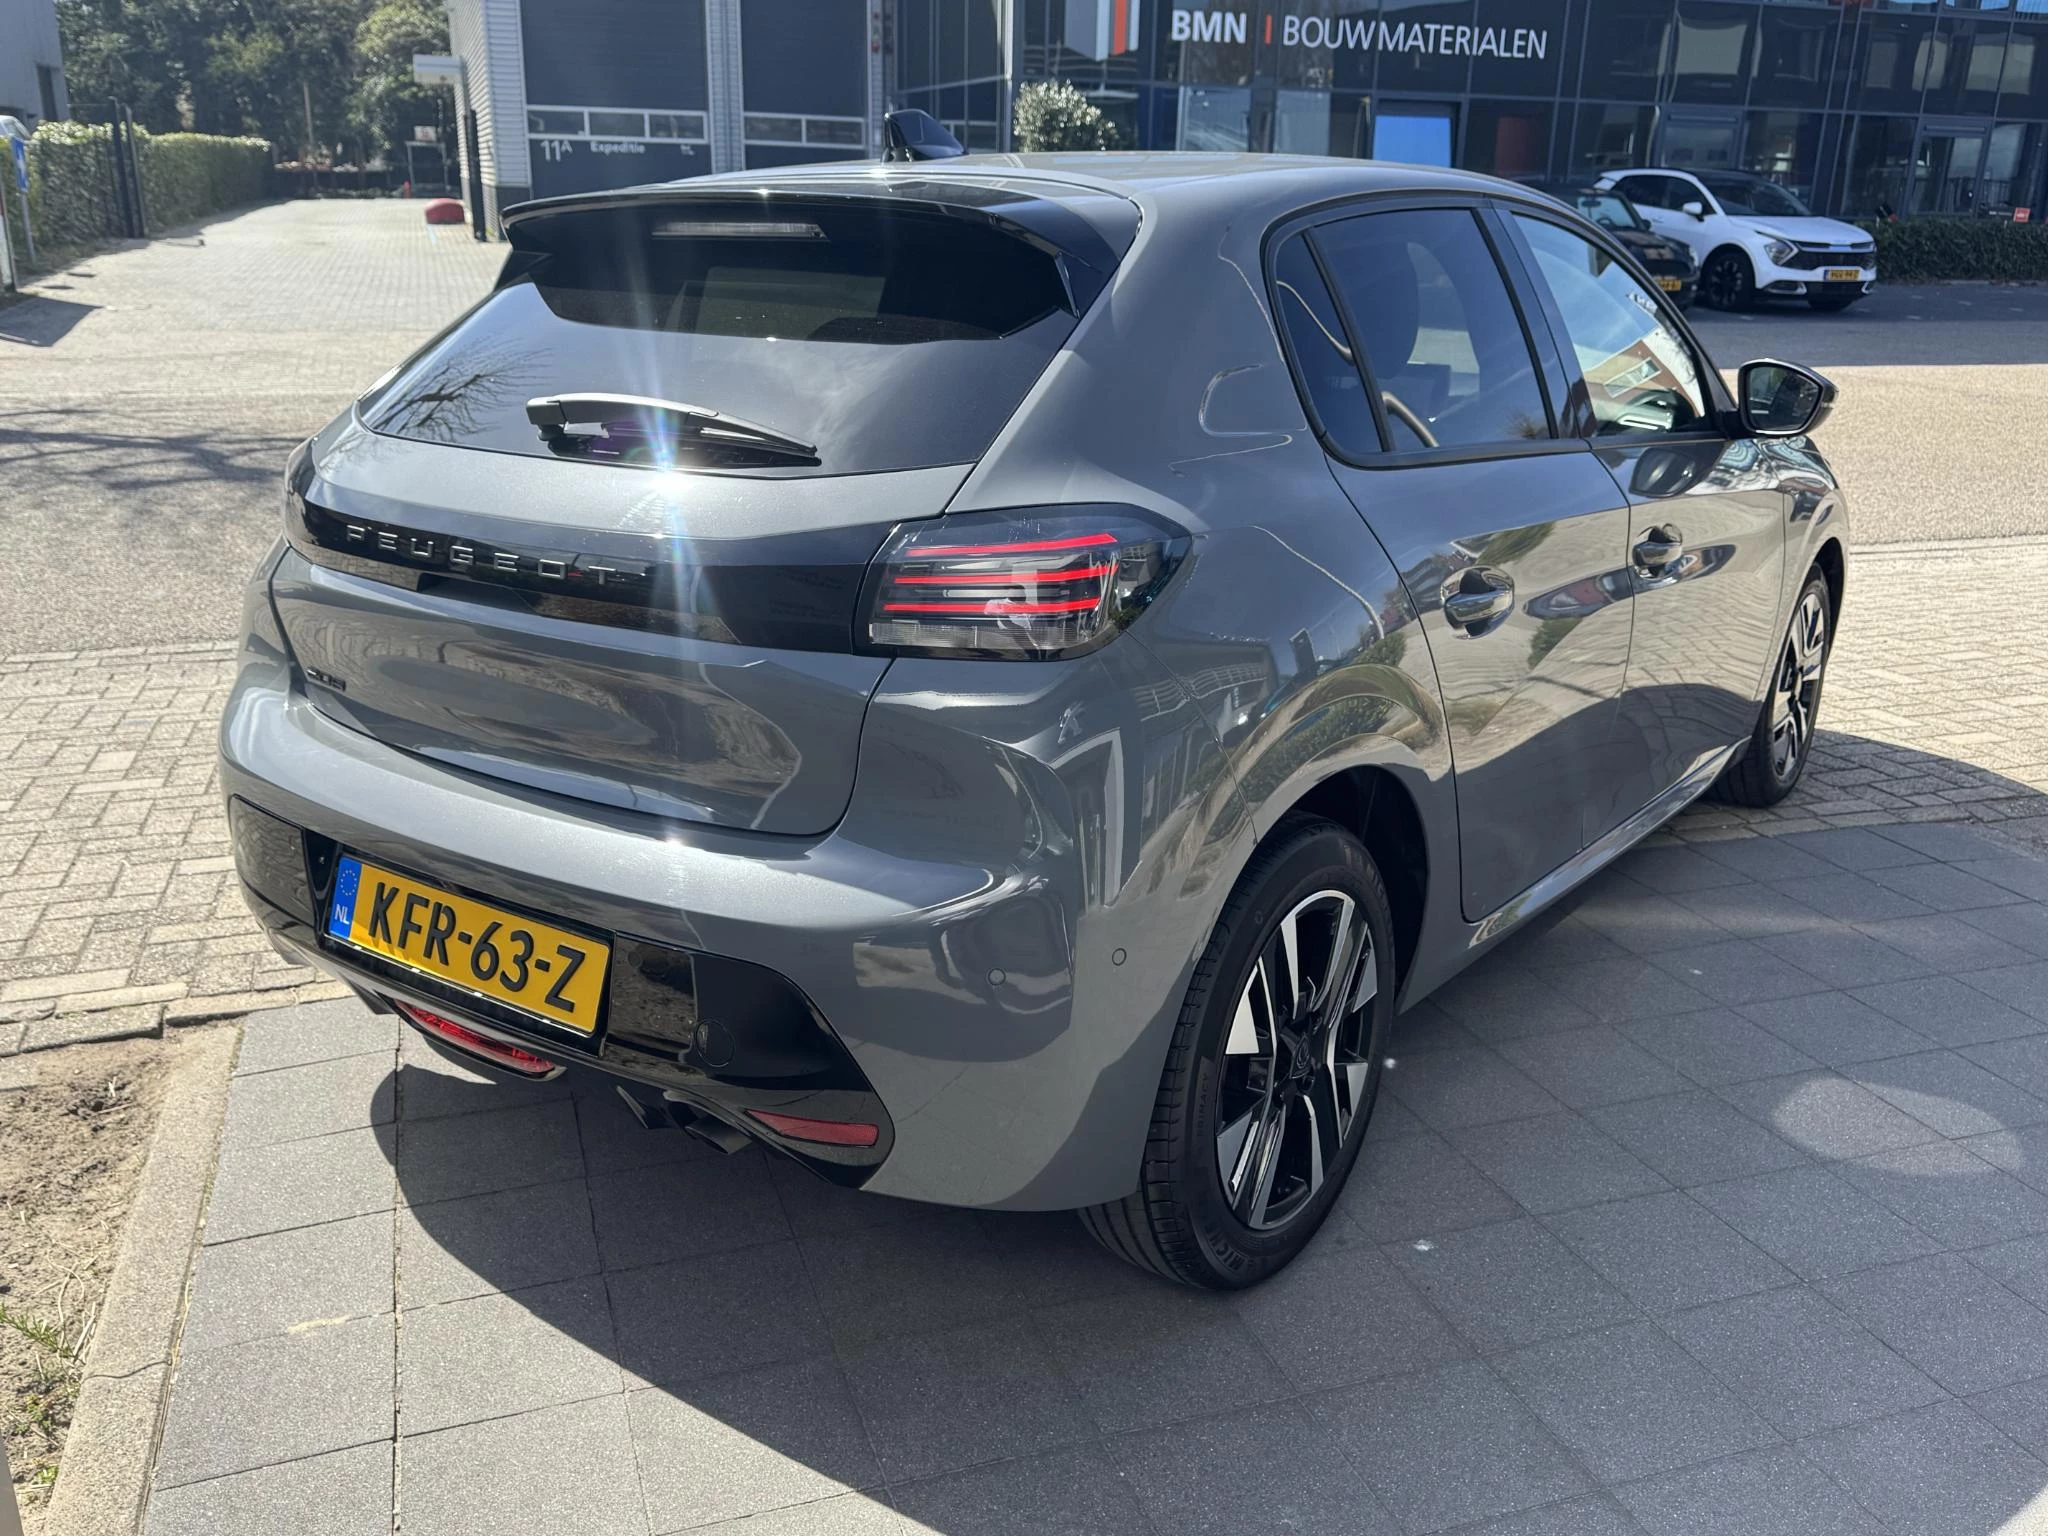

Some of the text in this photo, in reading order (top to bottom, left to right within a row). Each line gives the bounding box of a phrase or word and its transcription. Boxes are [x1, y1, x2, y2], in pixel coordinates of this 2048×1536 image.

[1171, 10, 1548, 60] BMN BOUWMATERIALEN
[345, 524, 617, 585] PEUGEOT
[334, 903, 351, 925] NL
[367, 881, 587, 1014] KFR-63-Z
